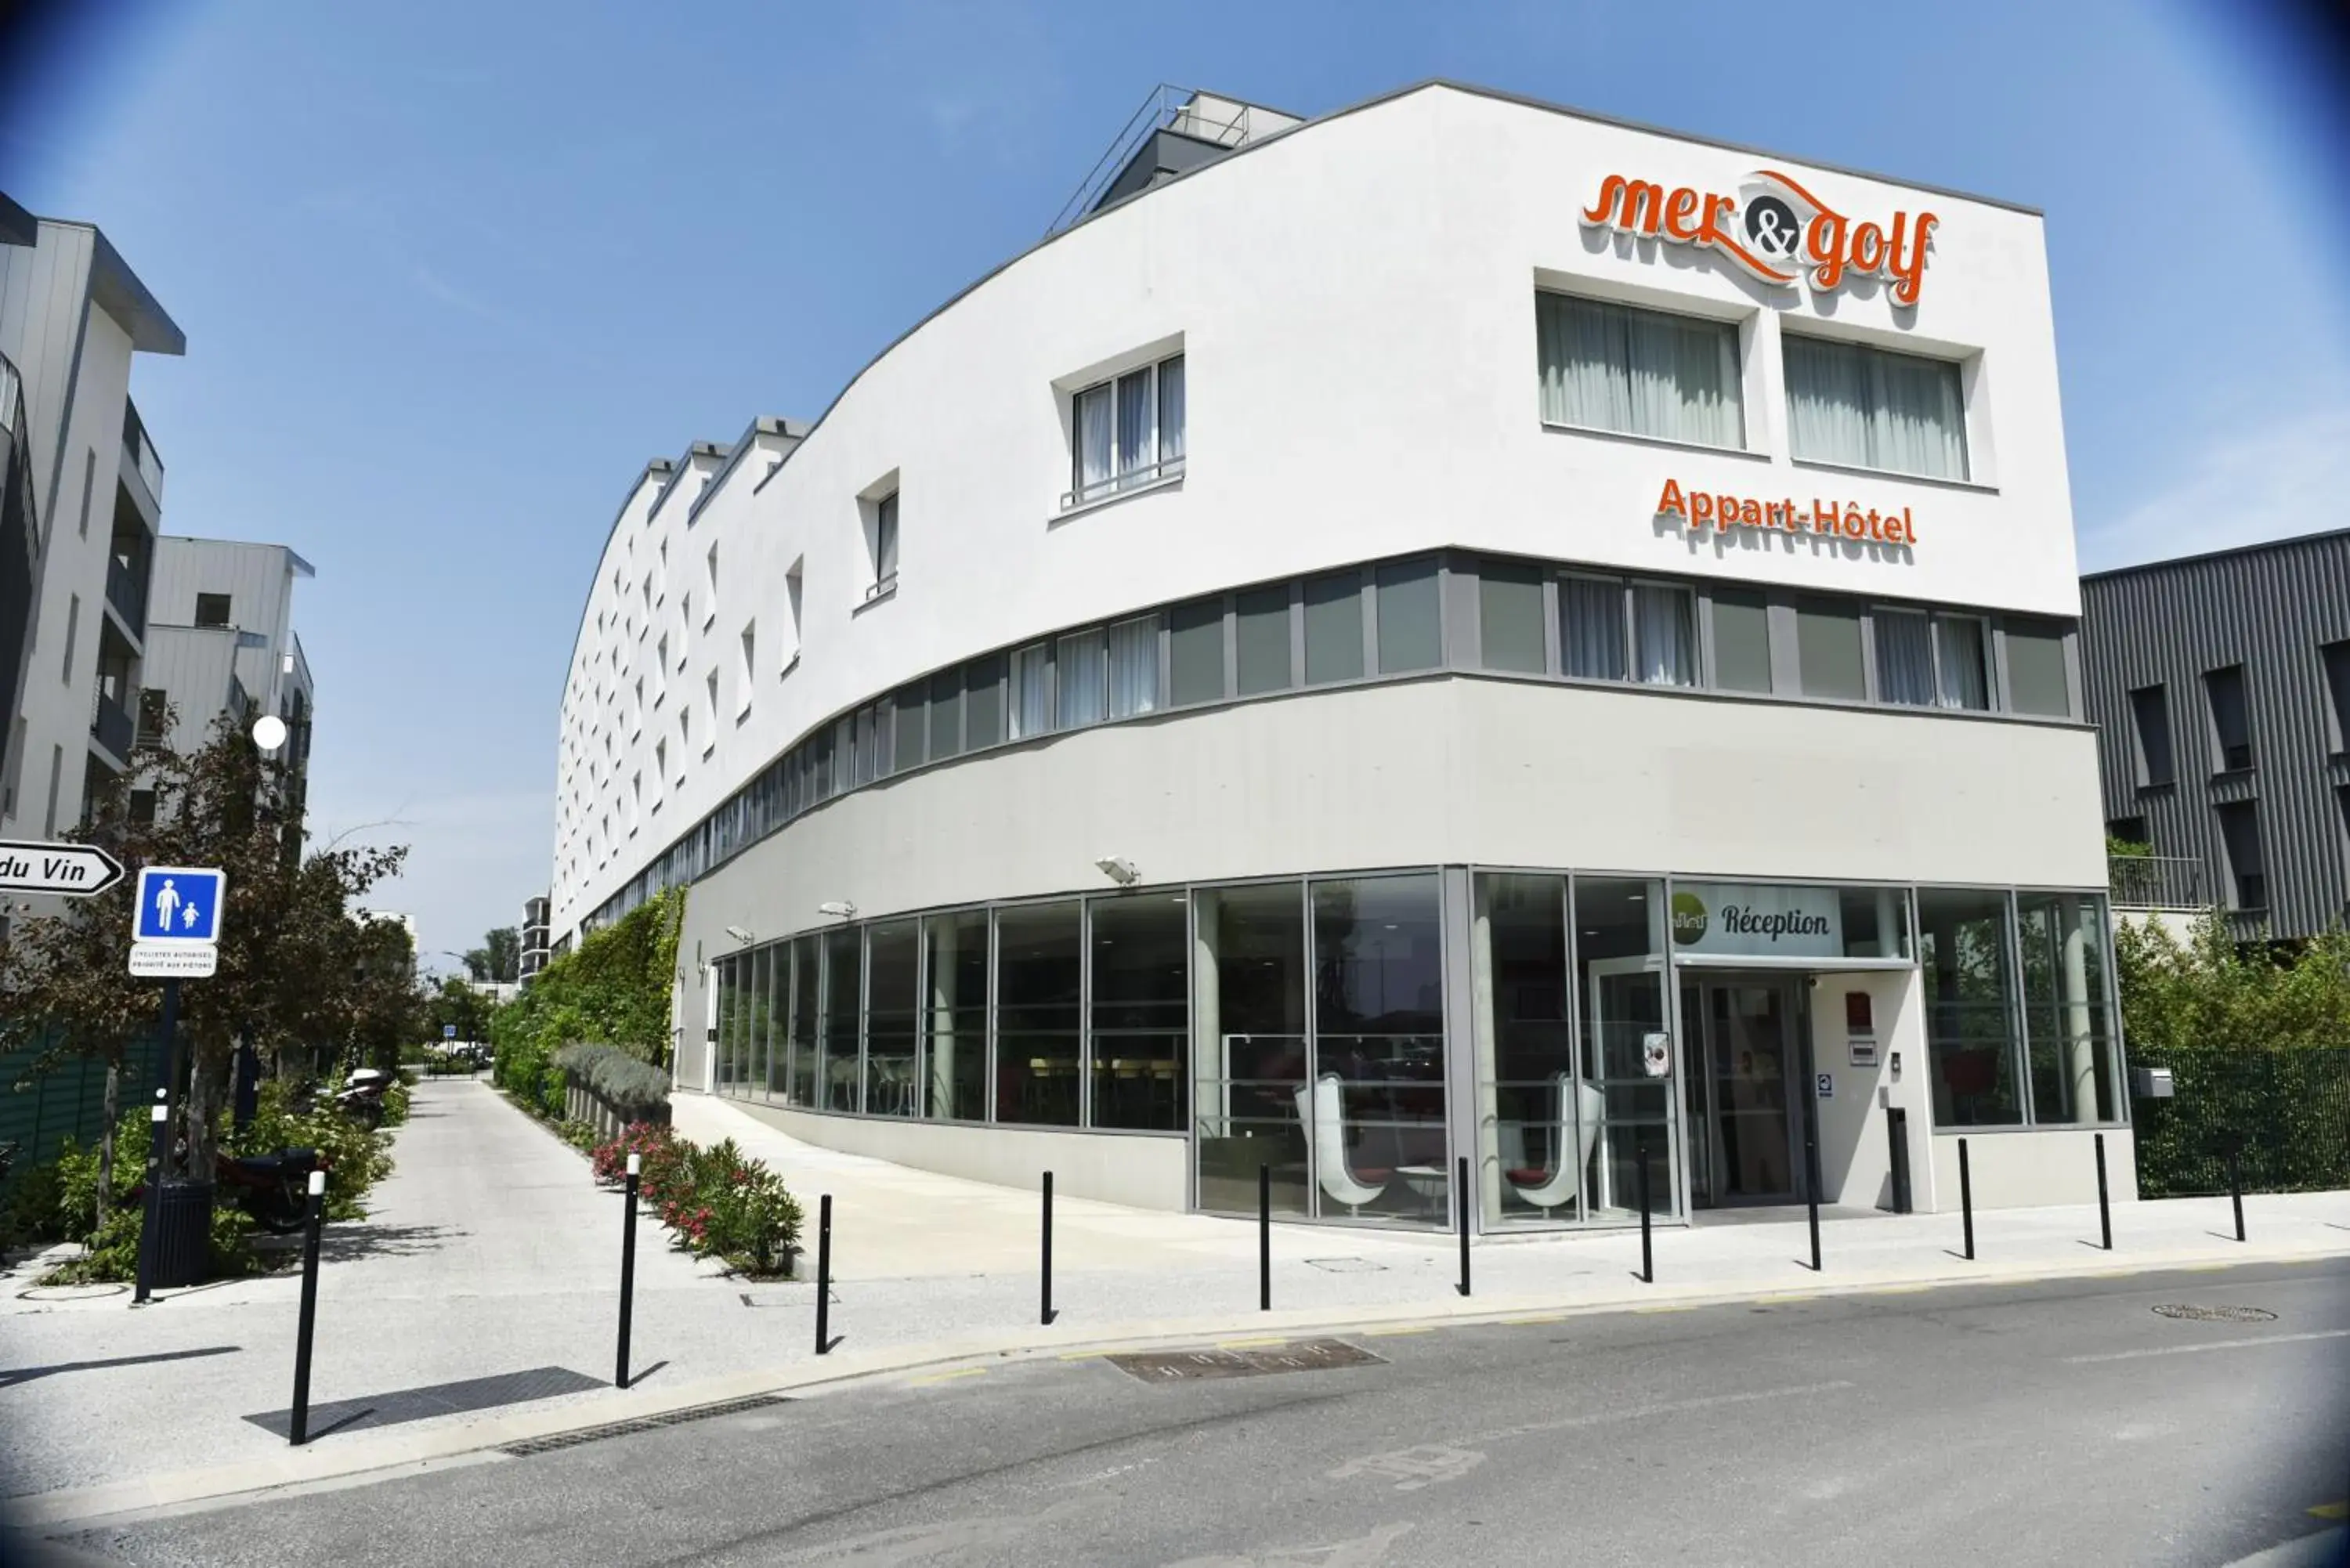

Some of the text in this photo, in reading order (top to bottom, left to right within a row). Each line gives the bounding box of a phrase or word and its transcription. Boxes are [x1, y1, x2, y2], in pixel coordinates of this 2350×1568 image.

[1582, 174, 1737, 244] mer
[1805, 210, 1940, 304] golf
[1657, 478, 1917, 544] Appart-Hôtel
[0, 855, 85, 881] du Vin
[1721, 904, 1831, 942] Réception
